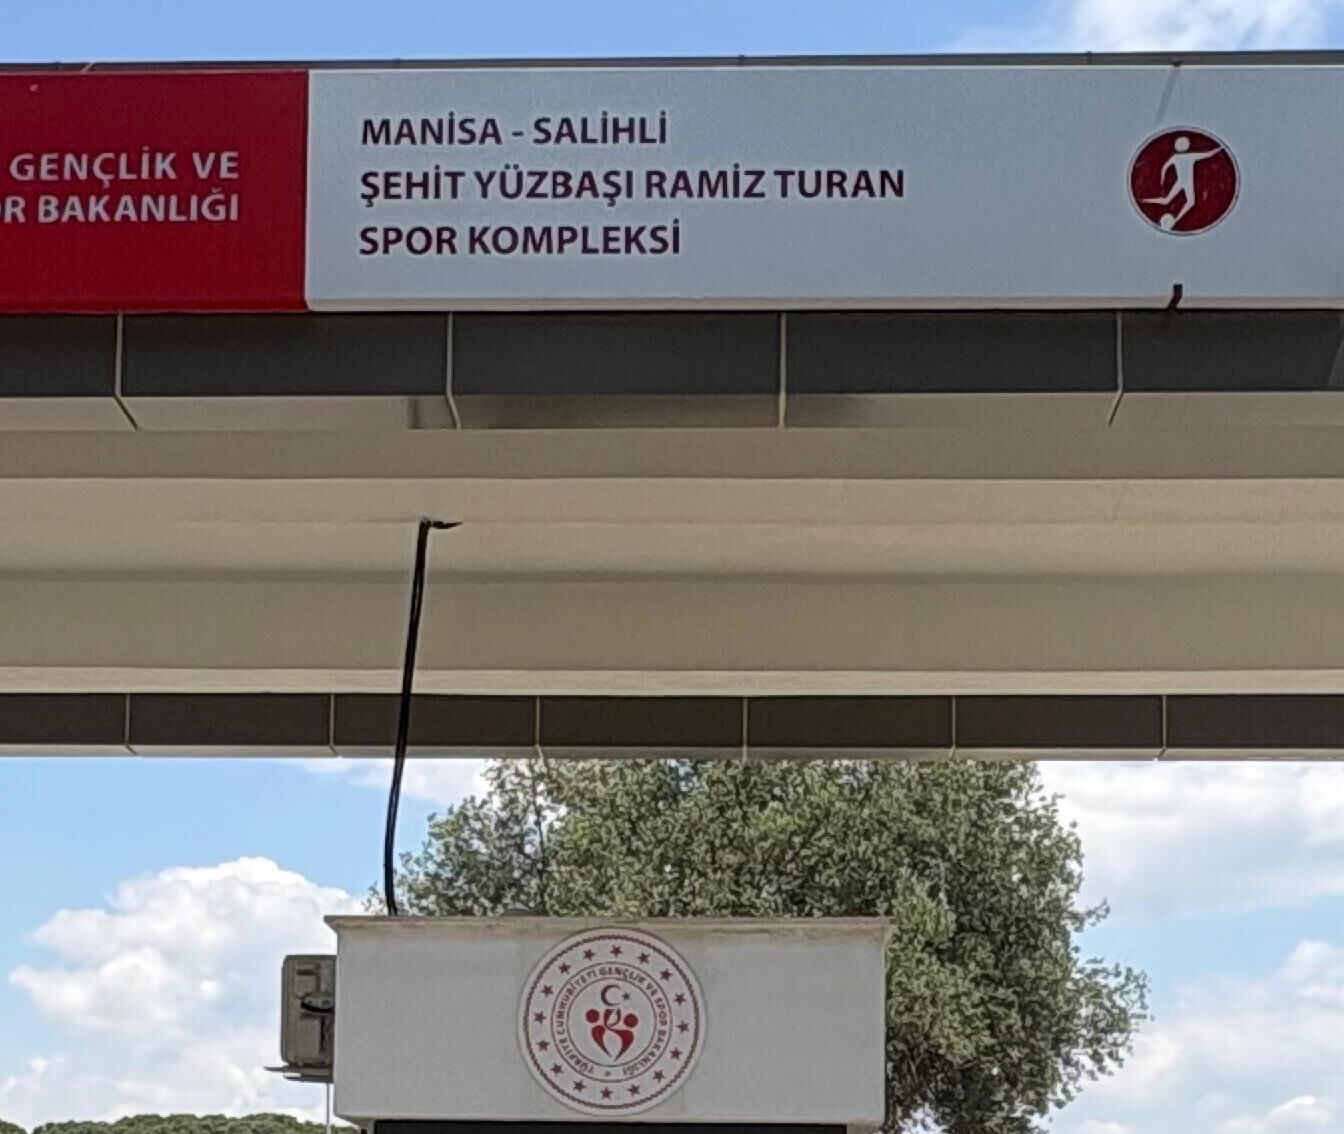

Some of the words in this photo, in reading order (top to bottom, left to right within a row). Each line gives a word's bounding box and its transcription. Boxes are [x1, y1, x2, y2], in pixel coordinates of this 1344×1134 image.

[363, 112, 501, 146] MANİSA
[532, 110, 667, 145] SALİHLİ
[8, 146, 177, 189] GENÇLİK
[191, 151, 239, 180] VE
[361, 165, 466, 208] ŞEHİT
[473, 164, 634, 208] YÜZBAŞI
[645, 163, 766, 199] RAMİZ
[773, 169, 904, 198] TURAN
[37, 187, 239, 224] BAKANLIĞI
[360, 226, 458, 256] SPOR
[468, 218, 680, 255] KOMPLEKSİ
